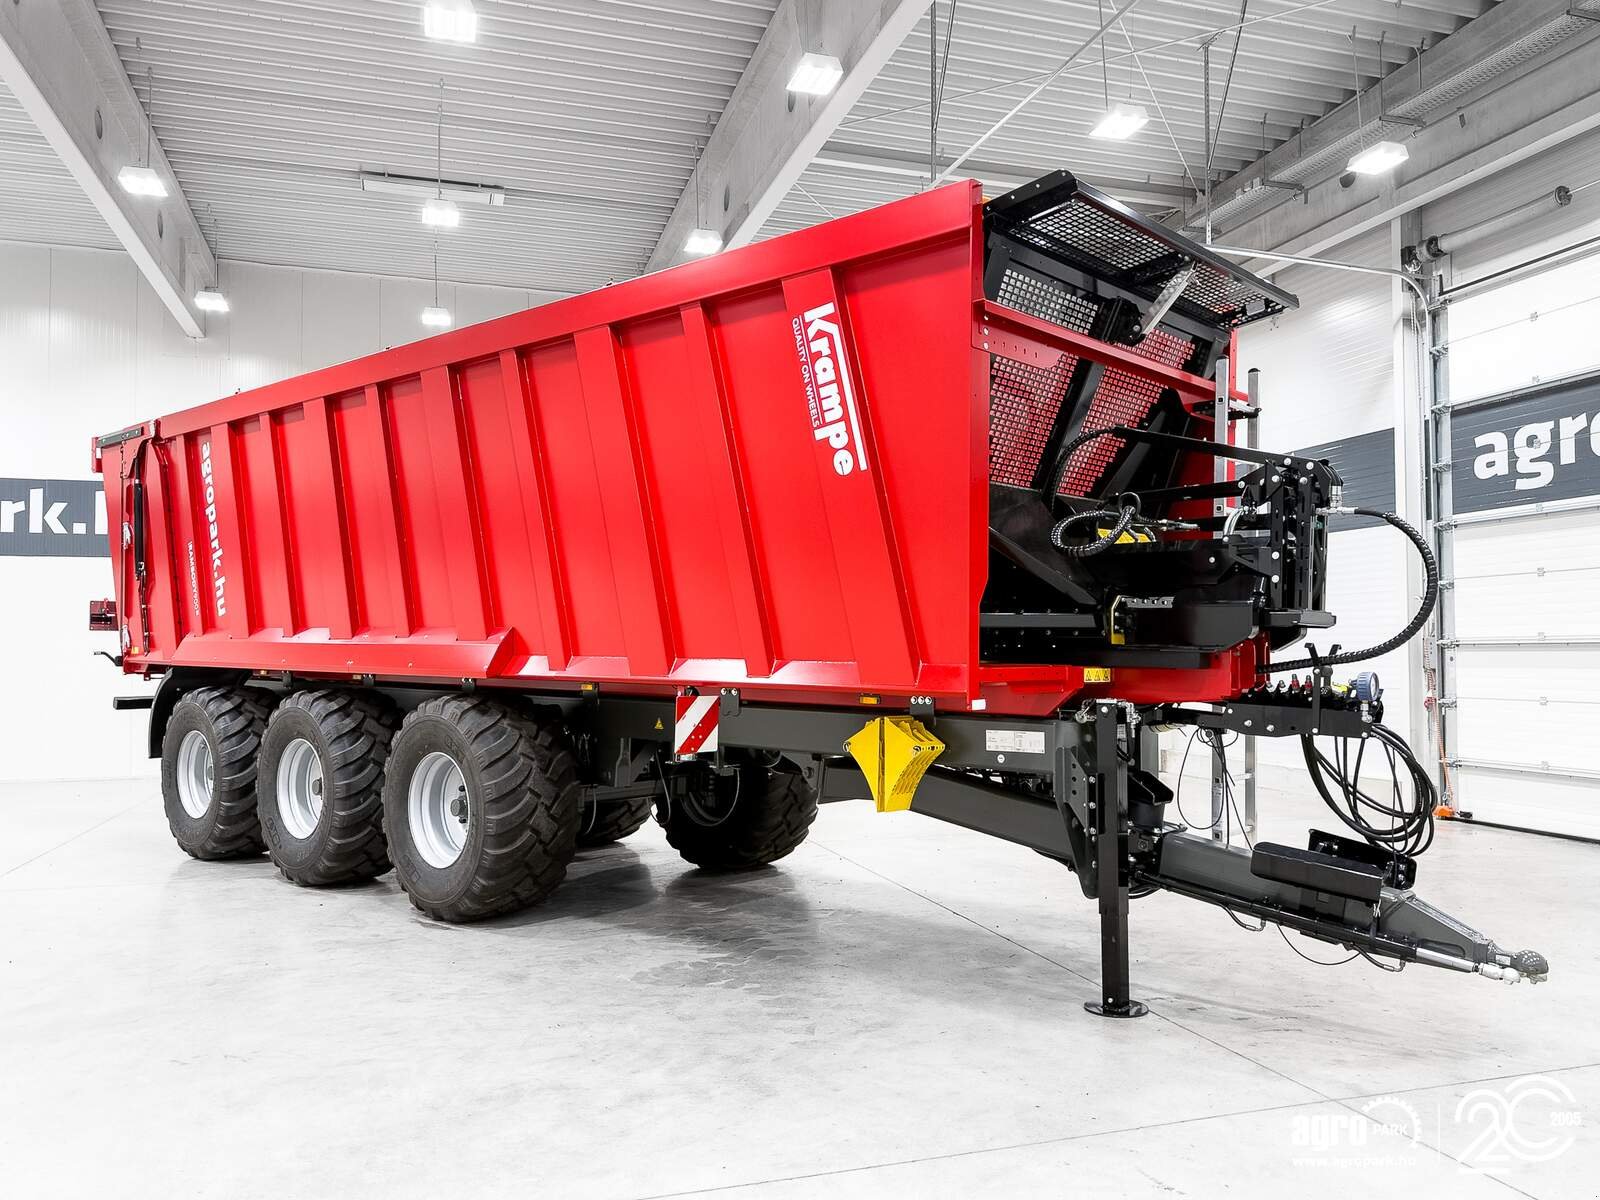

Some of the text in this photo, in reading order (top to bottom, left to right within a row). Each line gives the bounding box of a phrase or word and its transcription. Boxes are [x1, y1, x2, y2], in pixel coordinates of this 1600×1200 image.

[792, 318, 820, 428] QUALITY ON WHEELS
[804, 302, 868, 476] Krampe
[1473, 411, 1600, 490] agr
[202, 442, 226, 617] agropark.hu
